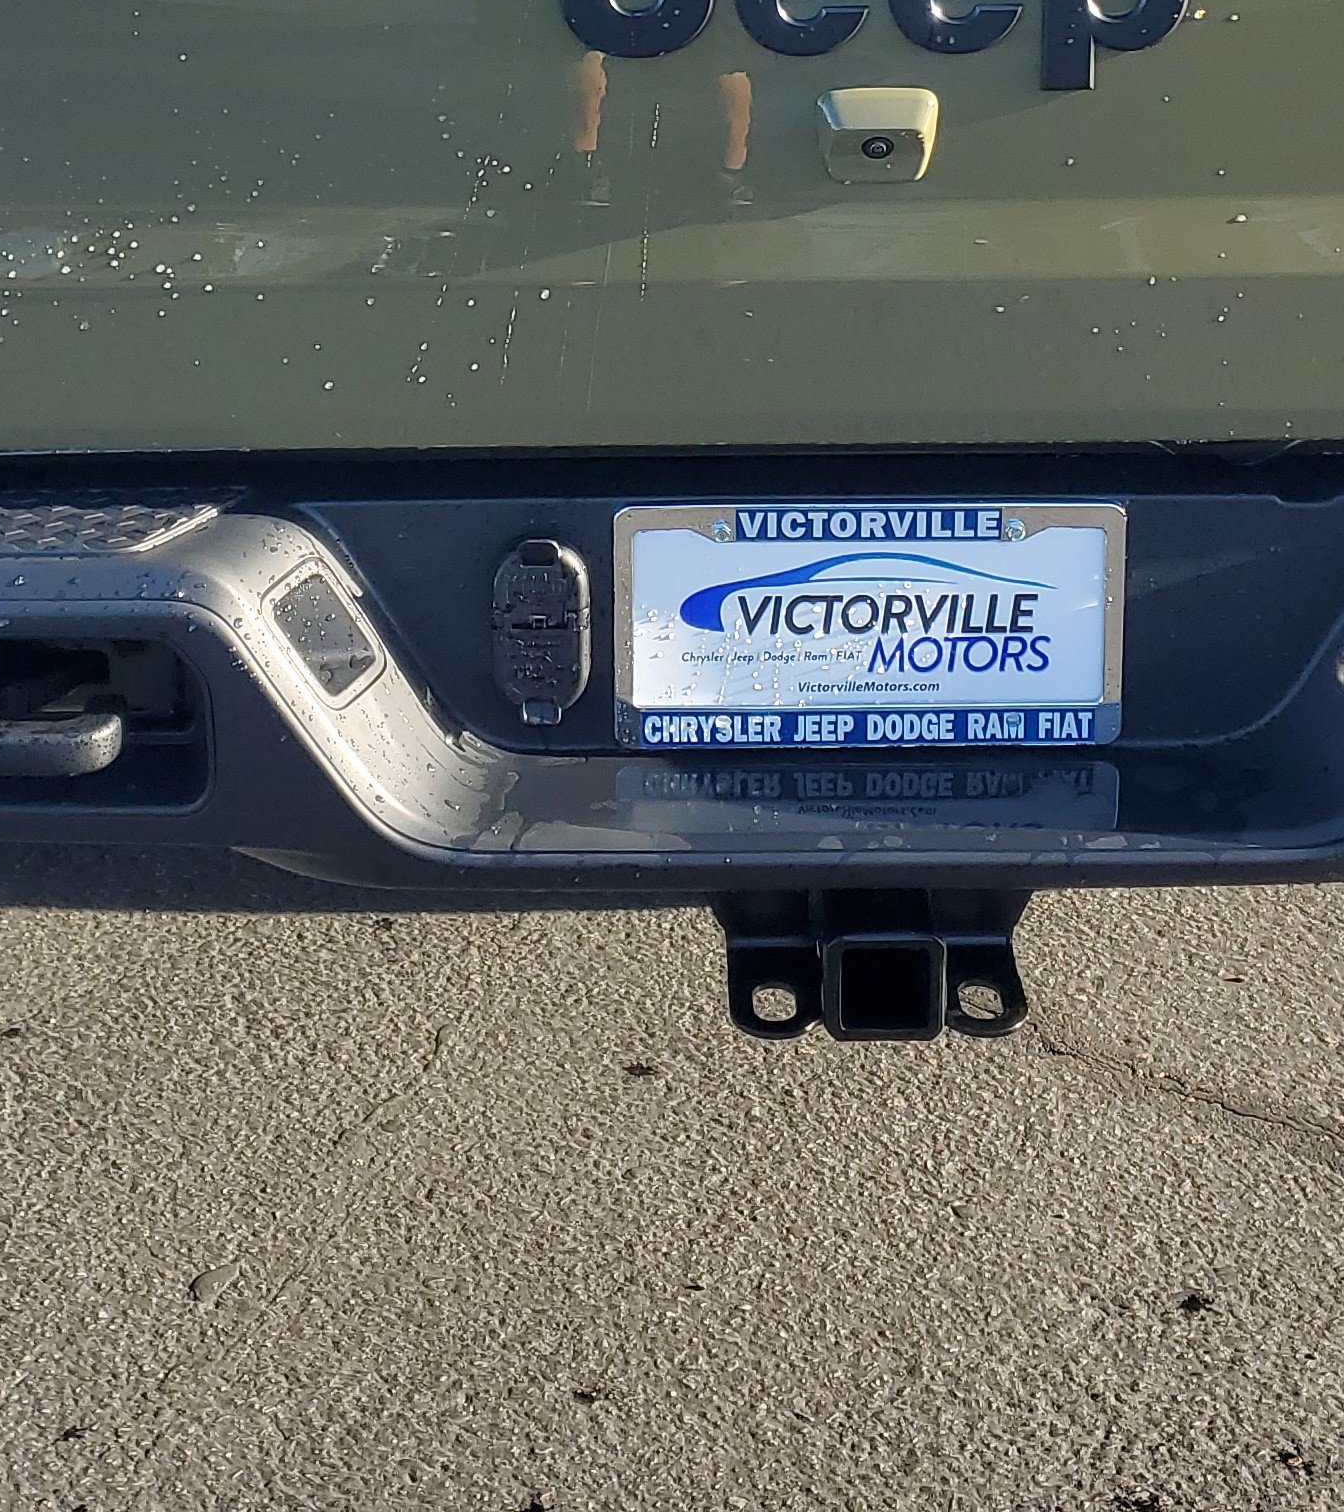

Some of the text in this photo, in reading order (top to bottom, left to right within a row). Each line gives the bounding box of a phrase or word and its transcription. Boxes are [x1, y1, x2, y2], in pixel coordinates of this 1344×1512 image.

[738, 510, 1002, 539] VICTORVILLE
[737, 593, 1039, 636] VICTORVILLE
[681, 650, 862, 666] Chrysler Jeep Dodge Ram FIAT
[867, 635, 1051, 674] MOTORS
[797, 680, 940, 694] VictorvilleMotors.com
[643, 711, 1093, 744] CHRYSLER JEEP DODGE RAM FIAT
